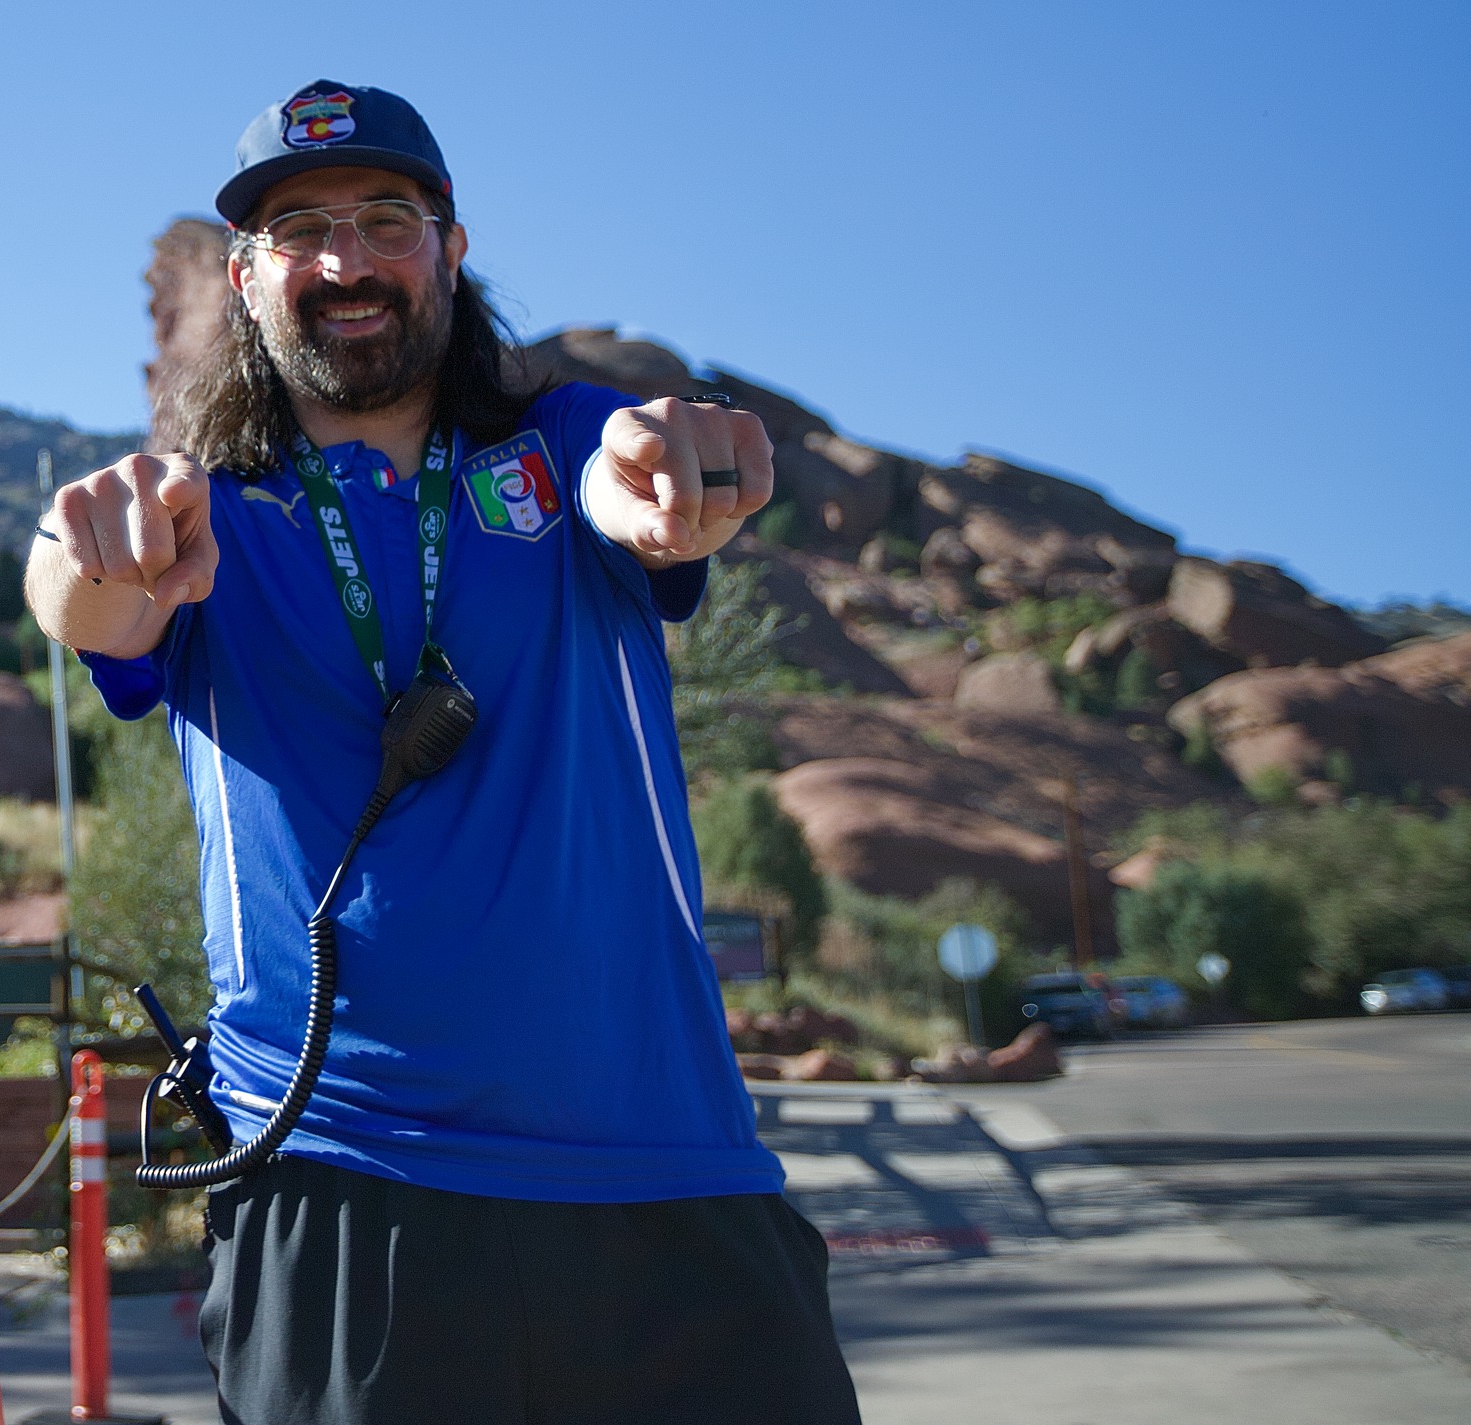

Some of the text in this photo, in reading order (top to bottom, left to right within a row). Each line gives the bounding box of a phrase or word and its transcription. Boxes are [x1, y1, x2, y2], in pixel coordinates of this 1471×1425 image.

[426, 430, 448, 471] ETS
[471, 442, 529, 471] ITALIA
[319, 506, 359, 577] JETS
[351, 584, 366, 612] JETS
